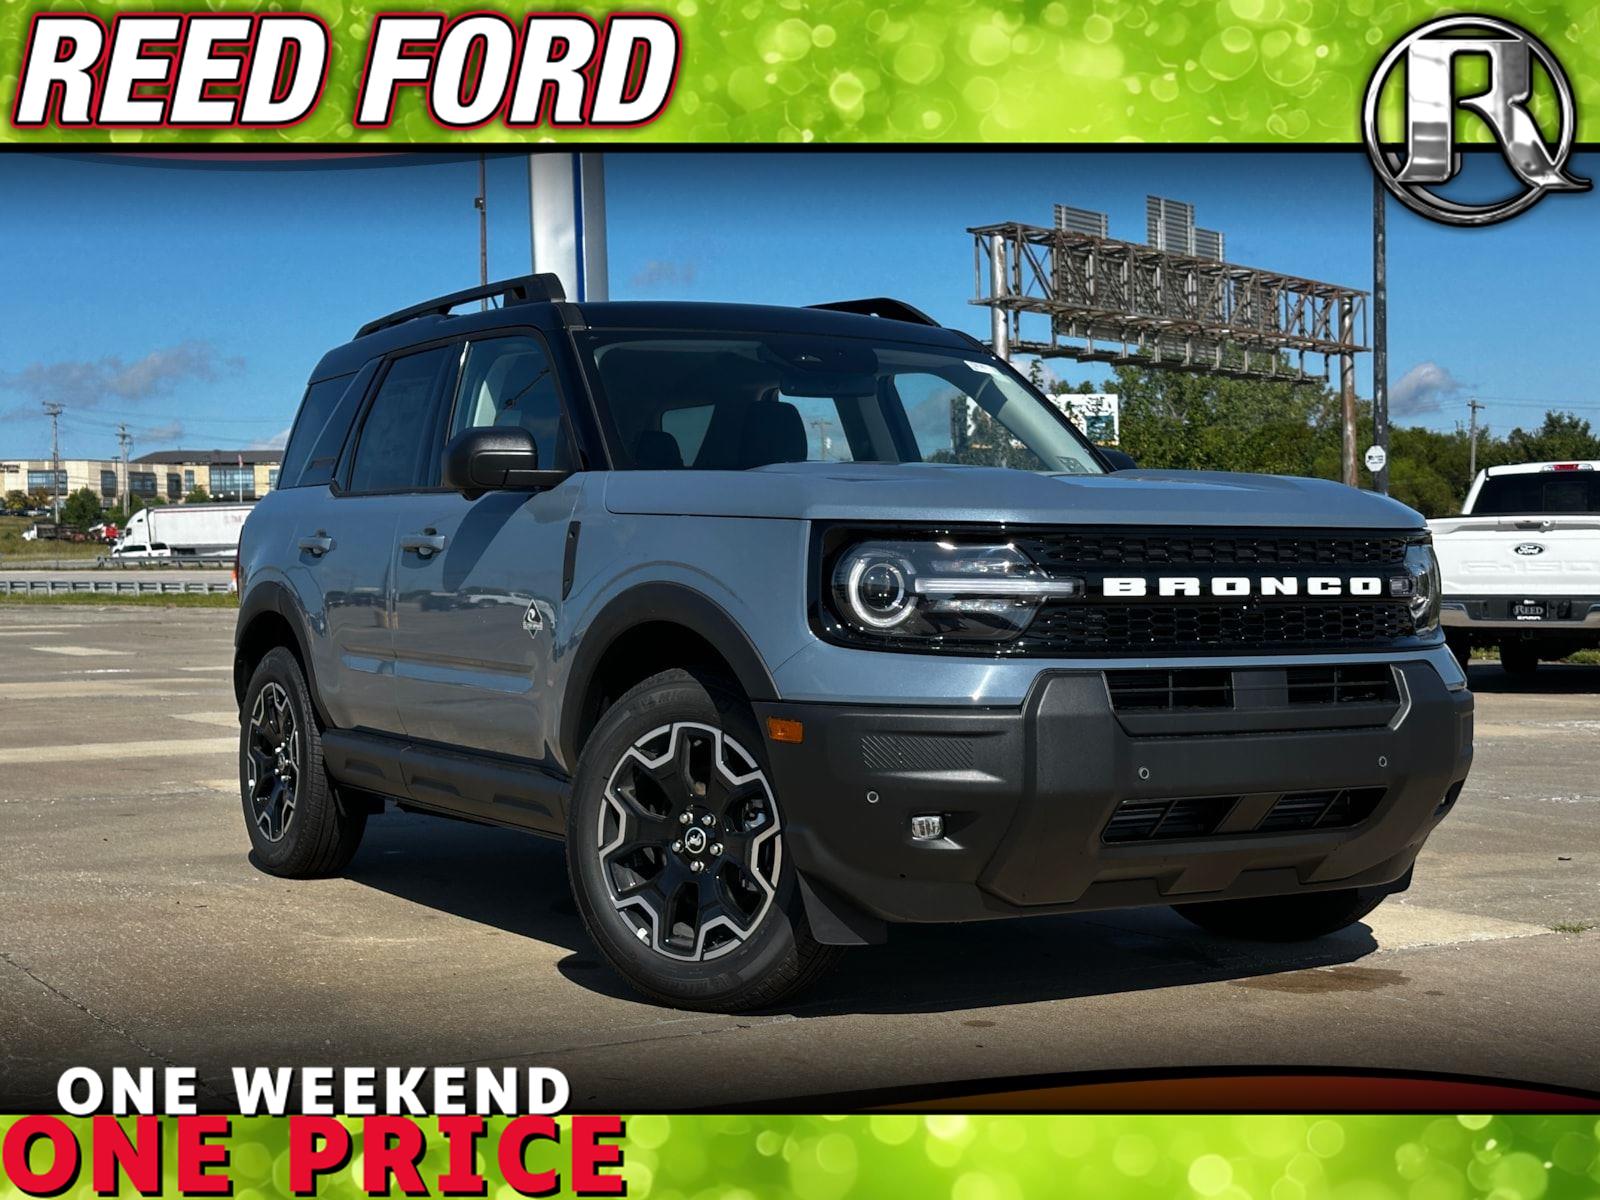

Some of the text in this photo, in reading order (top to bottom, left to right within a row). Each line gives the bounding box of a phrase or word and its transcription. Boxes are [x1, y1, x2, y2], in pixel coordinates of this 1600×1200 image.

[1516, 543, 1542, 554] Ford
[1103, 577, 1381, 596] BRONCO
[1513, 605, 1544, 615] REED
